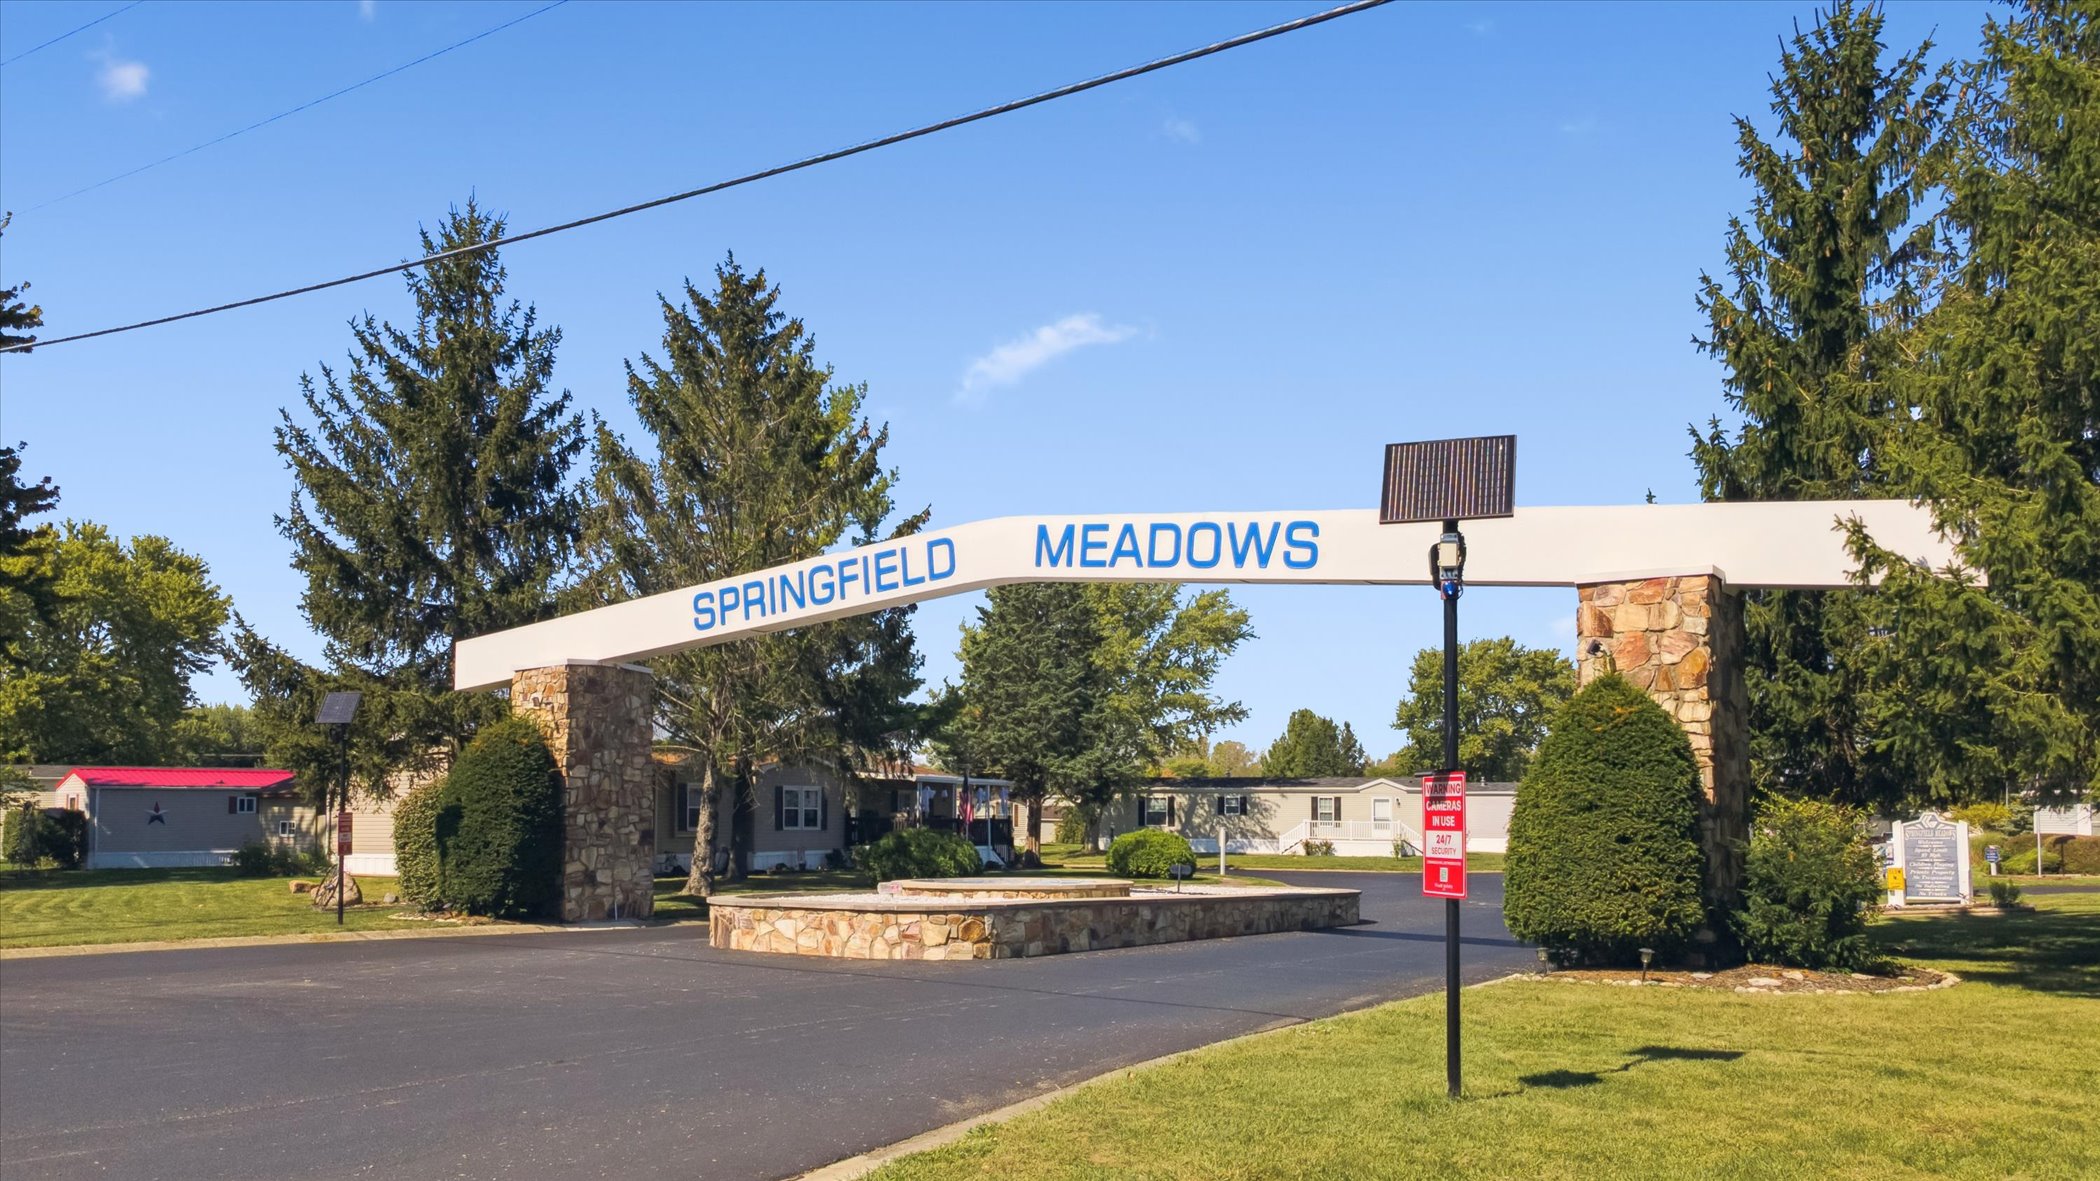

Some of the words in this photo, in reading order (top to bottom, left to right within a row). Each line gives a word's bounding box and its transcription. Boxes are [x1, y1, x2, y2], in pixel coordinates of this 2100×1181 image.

[692, 536, 956, 631] SPRINGFIELD
[1035, 520, 1320, 569] MEADOWS
[1425, 783, 1461, 795] WARNING
[1425, 800, 1461, 811] CAMERAS
[1432, 816, 1440, 826] IN
[1440, 816, 1455, 826] USE
[1436, 834, 1452, 846] 24/7
[1431, 847, 1456, 855] SECURITY
